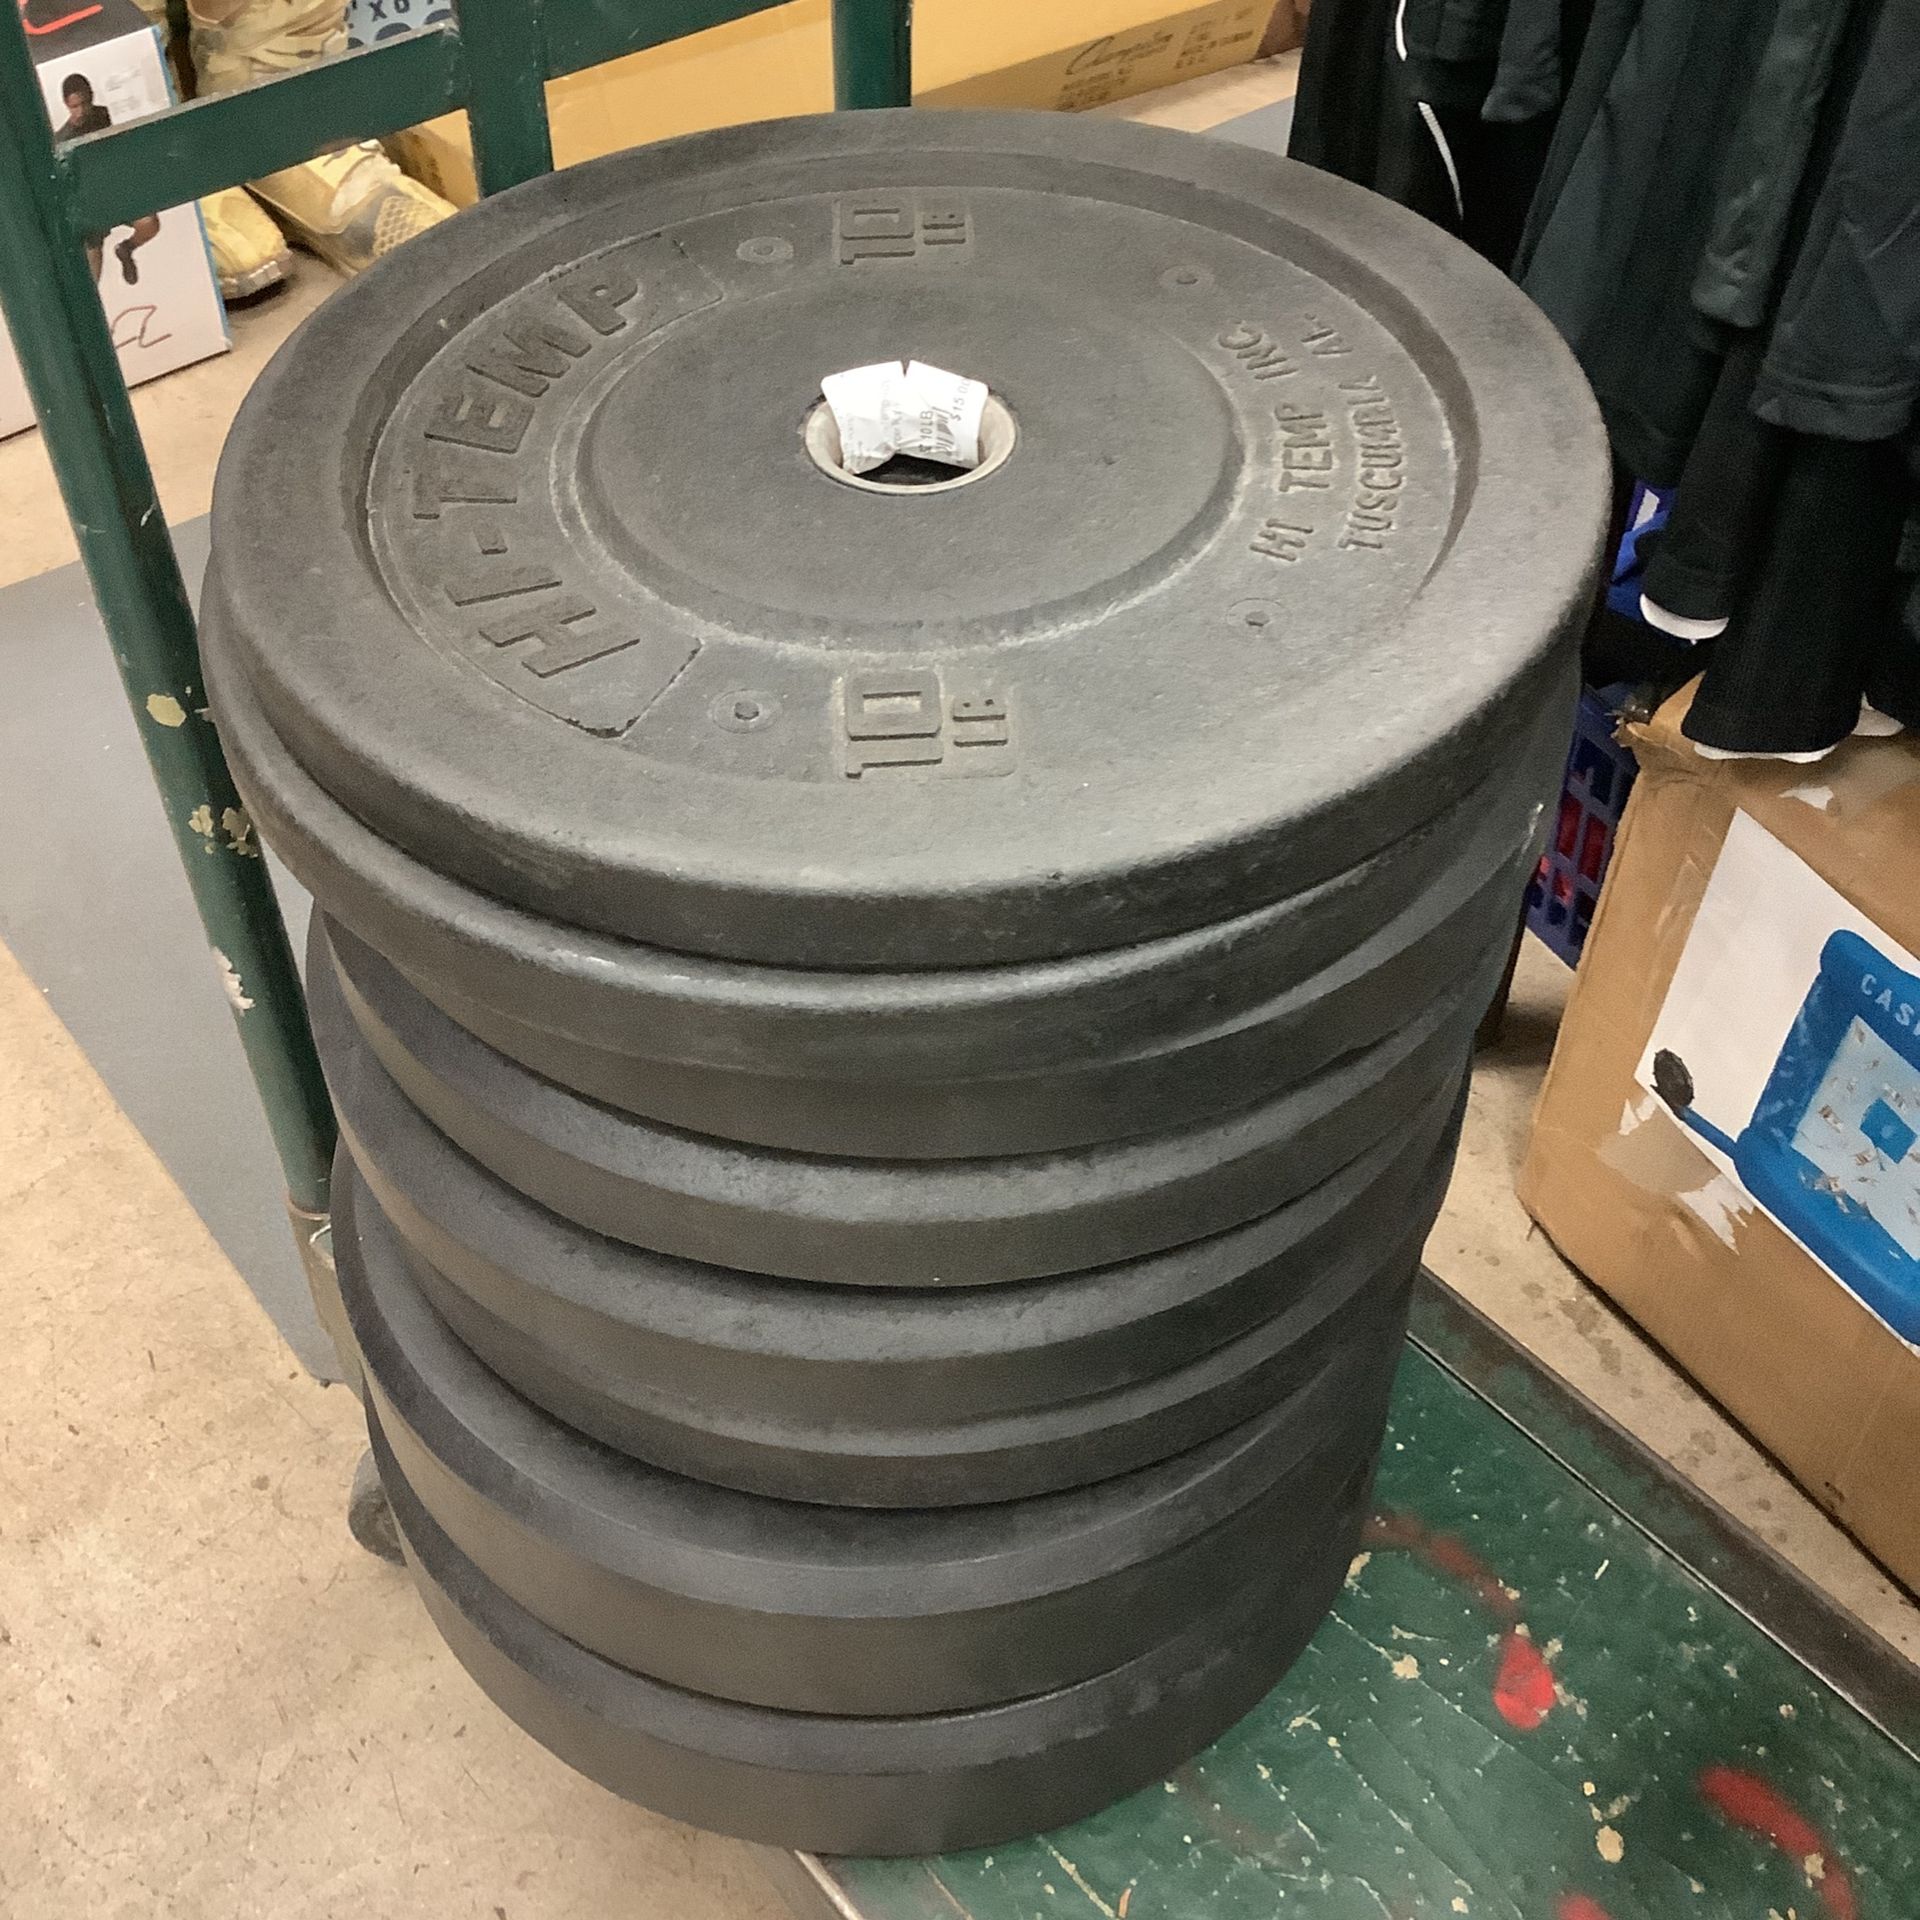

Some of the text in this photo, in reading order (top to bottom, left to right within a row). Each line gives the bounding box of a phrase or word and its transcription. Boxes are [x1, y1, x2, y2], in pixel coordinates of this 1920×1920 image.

[840, 199, 915, 265] 10
[412, 267, 642, 680] HI-TEMP
[1273, 401, 1334, 493] TEMP
[1249, 518, 1315, 562] HI
[845, 666, 944, 780] 10
